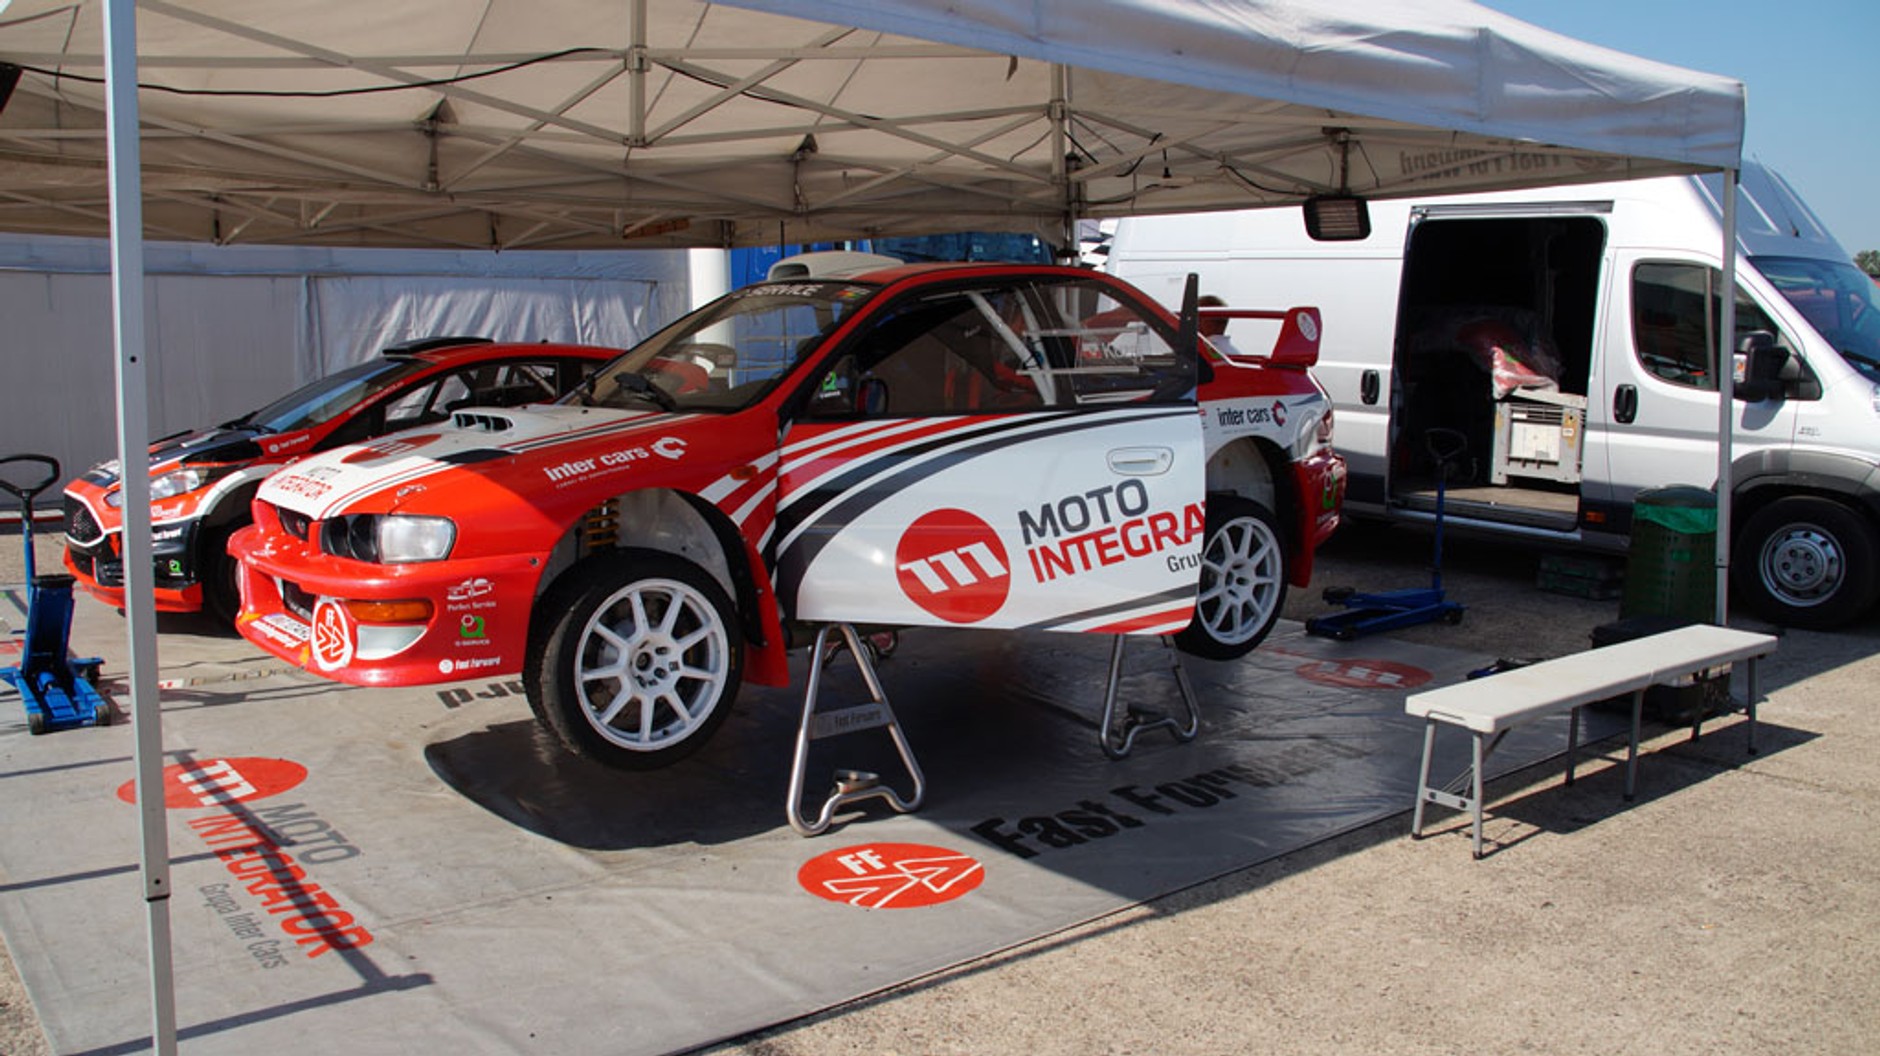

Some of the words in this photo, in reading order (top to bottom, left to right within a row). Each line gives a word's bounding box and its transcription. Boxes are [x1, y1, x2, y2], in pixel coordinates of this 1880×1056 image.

[1216, 406, 1245, 427] inter
[1246, 406, 1271, 423] cars
[543, 457, 597, 483] inter
[600, 446, 650, 466] cars
[1018, 478, 1149, 545] MOTO
[1028, 499, 1206, 584] INTEGRA
[250, 802, 362, 866] MOTO
[969, 799, 1147, 859] Fast
[186, 813, 375, 959] INTEGRATOR
[837, 848, 887, 876] FF
[224, 911, 264, 941] Inter
[248, 937, 289, 970] Cars
